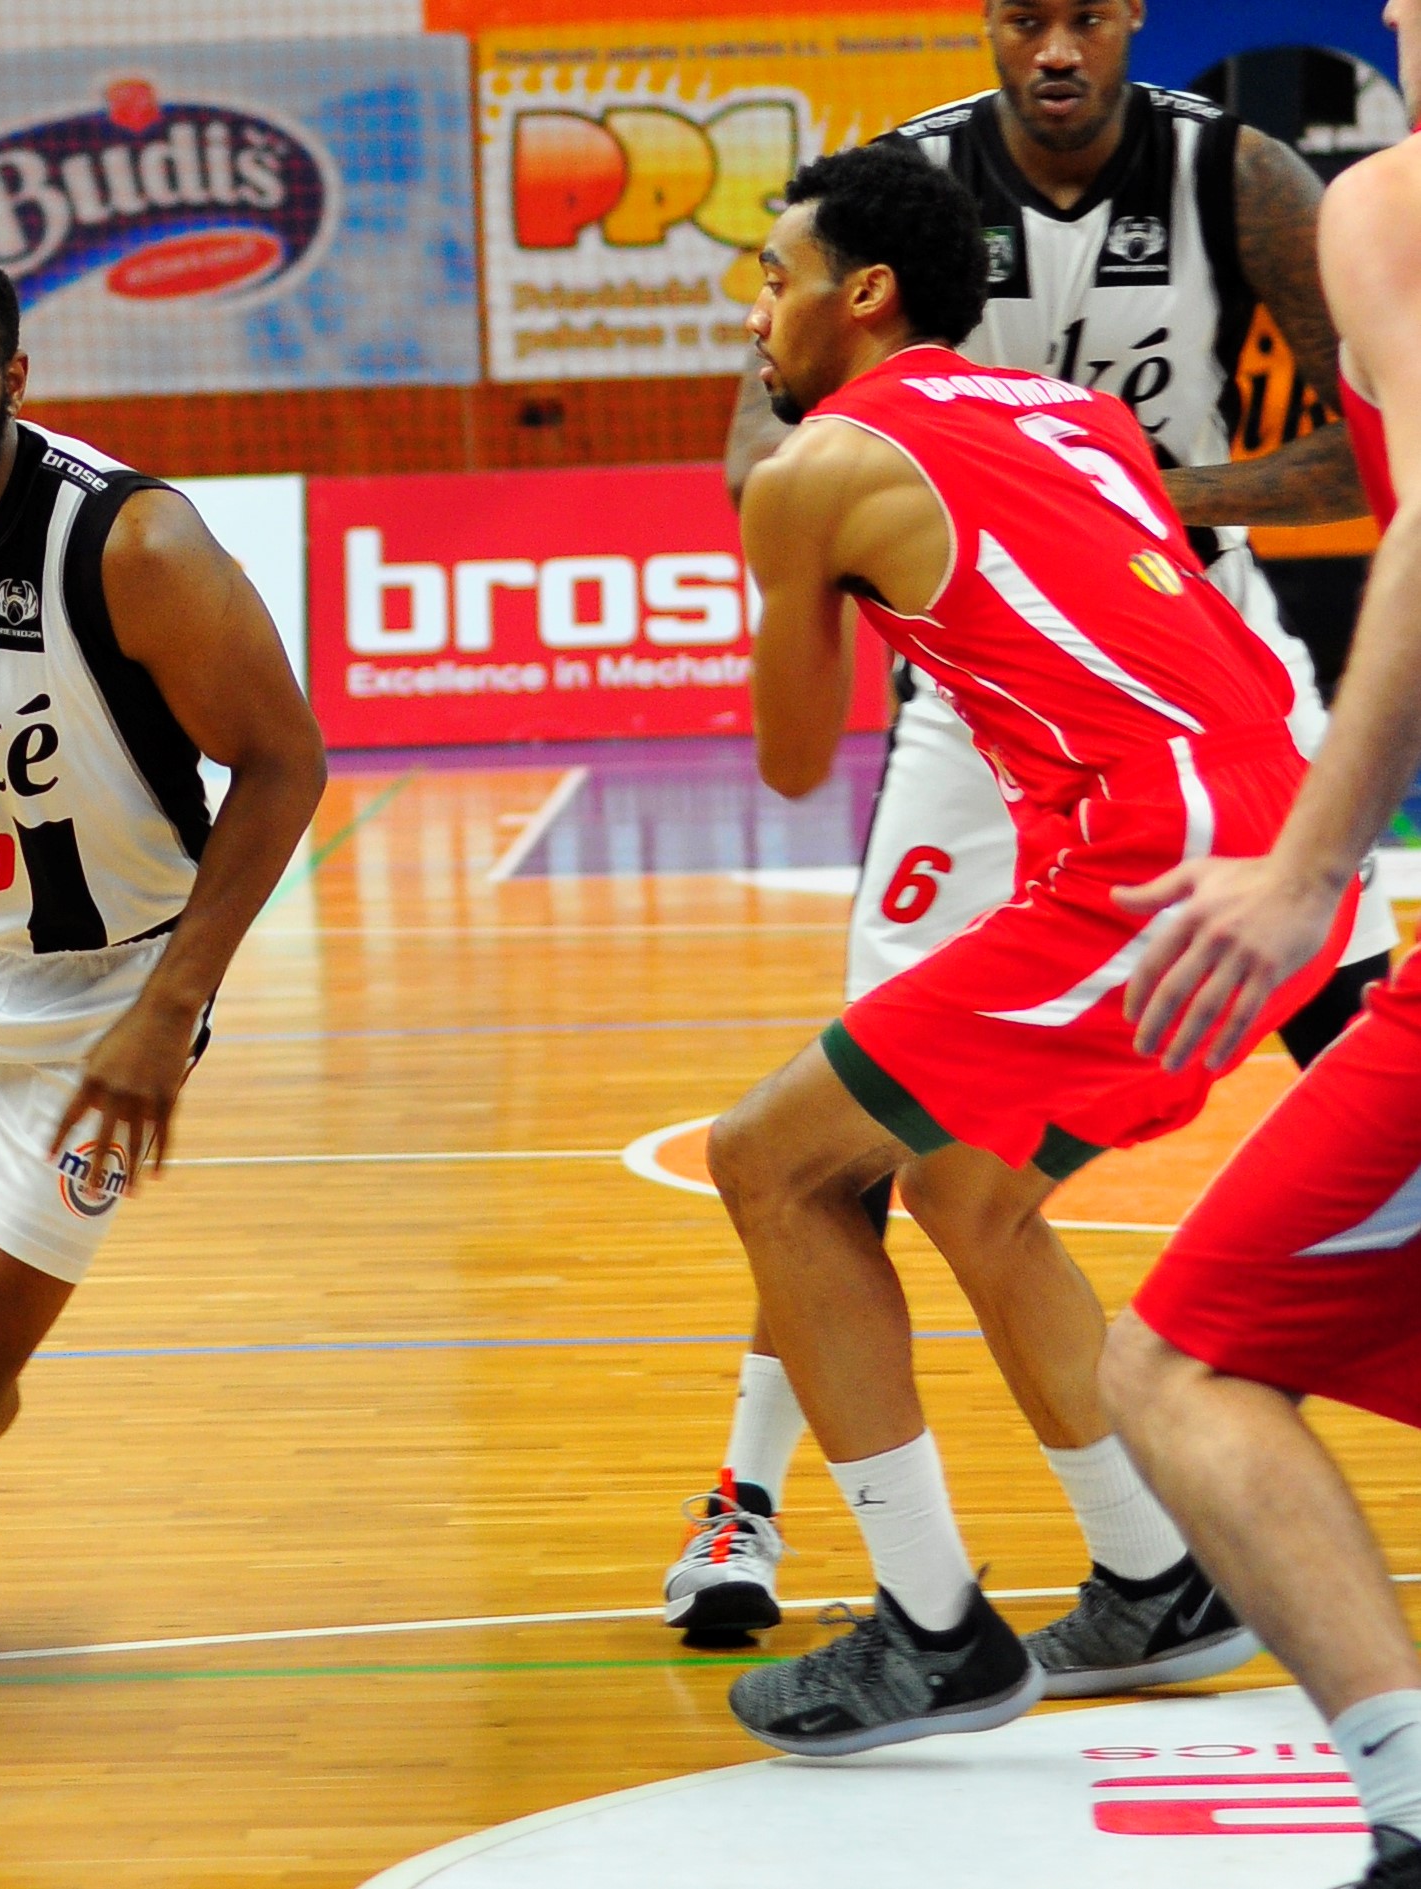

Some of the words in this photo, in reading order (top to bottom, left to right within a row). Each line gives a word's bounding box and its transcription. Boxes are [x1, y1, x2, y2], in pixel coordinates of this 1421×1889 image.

[41, 448, 109, 492] brose
[1014, 411, 1168, 540] 5
[342, 525, 764, 655] bros
[346, 661, 547, 698] Excellence
[554, 657, 590, 690] in
[598, 653, 754, 688] Mechatr
[880, 845, 953, 923] 6
